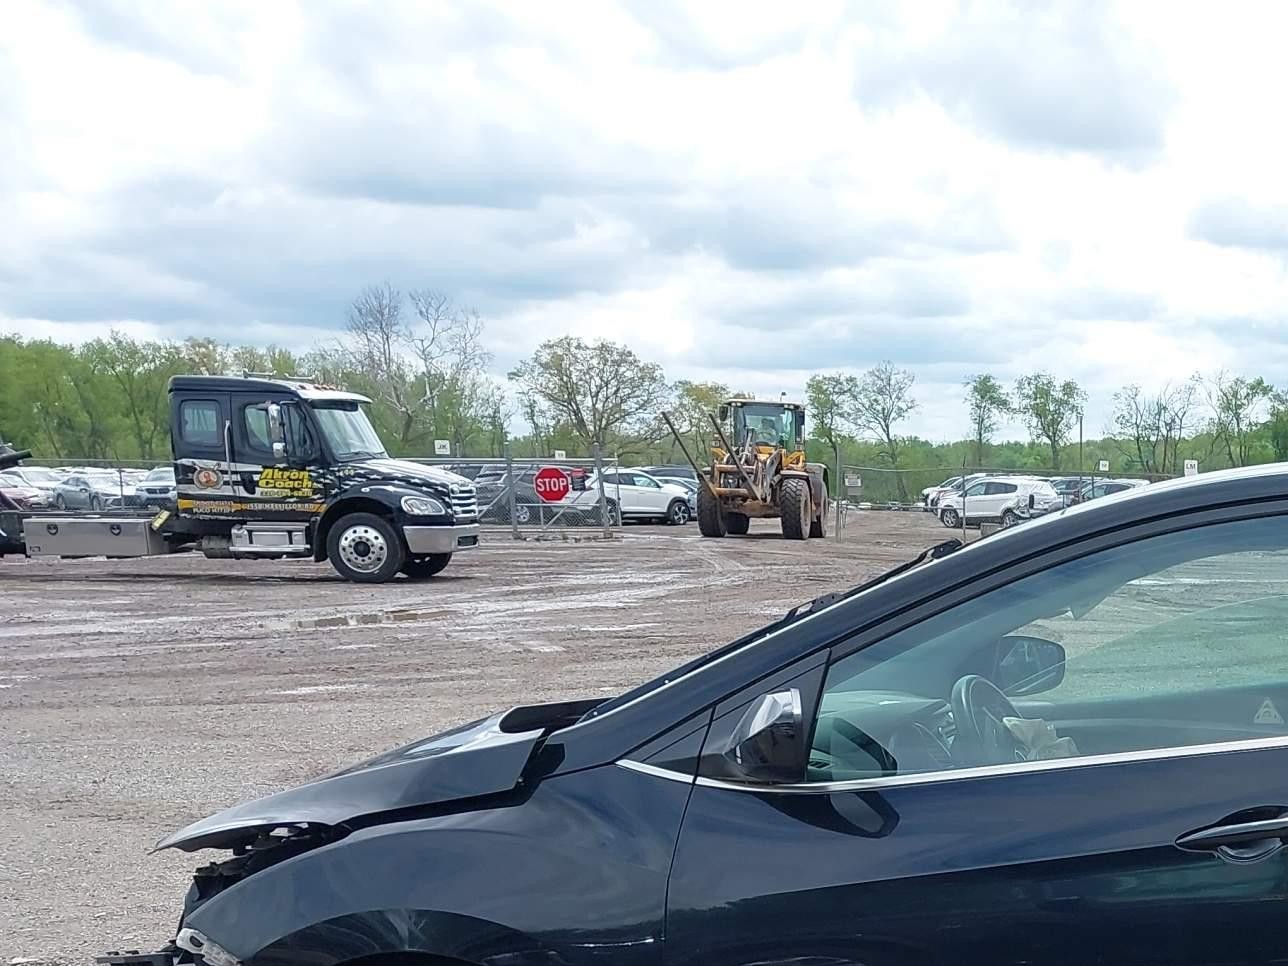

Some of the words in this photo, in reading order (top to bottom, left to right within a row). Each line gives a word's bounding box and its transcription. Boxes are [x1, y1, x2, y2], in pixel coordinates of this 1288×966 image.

[1185, 463, 1197, 471] LM
[260, 468, 309, 480] Akron
[258, 478, 312, 489] Coach
[536, 478, 567, 492] STOP
